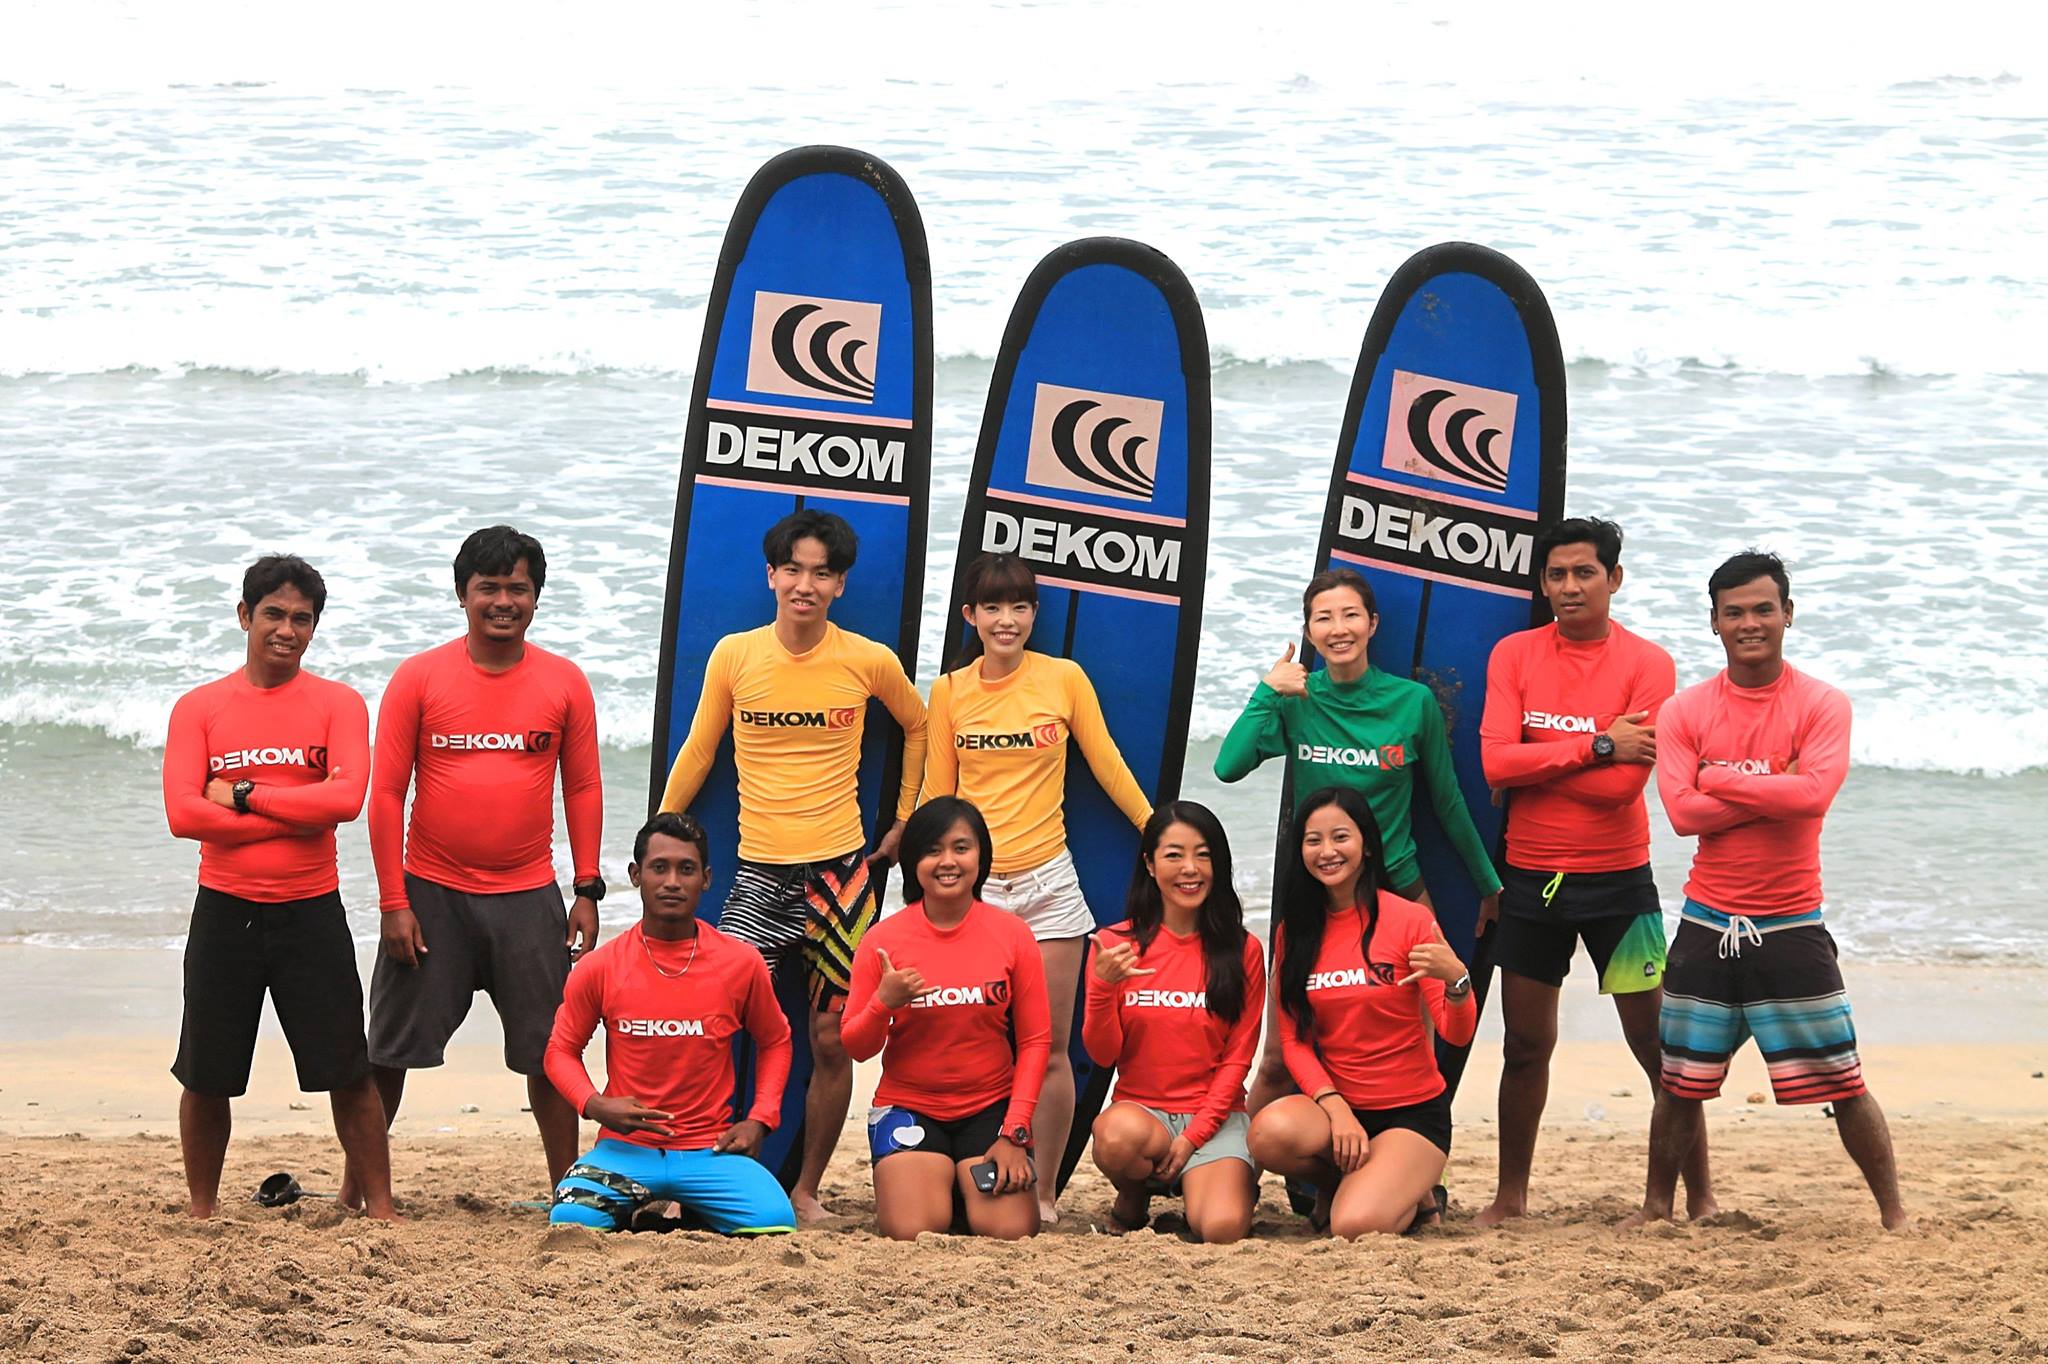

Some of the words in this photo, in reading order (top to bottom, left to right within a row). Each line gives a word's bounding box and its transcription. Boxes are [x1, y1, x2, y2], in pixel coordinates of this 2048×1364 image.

[706, 422, 905, 483] DEKOM
[981, 510, 1182, 582] DEKOM
[1338, 495, 1533, 576] DEKOM
[740, 710, 826, 728] DEKOM
[431, 732, 525, 751] DEKOM
[956, 732, 1034, 751] DEKOM
[210, 747, 305, 772] DEKOM
[1298, 743, 1379, 767] DEKOM
[1305, 968, 1367, 991] EKOM
[909, 986, 984, 1008] EKOM
[1124, 990, 1207, 1008] DEKOM
[617, 1018, 703, 1037] DEKOM
